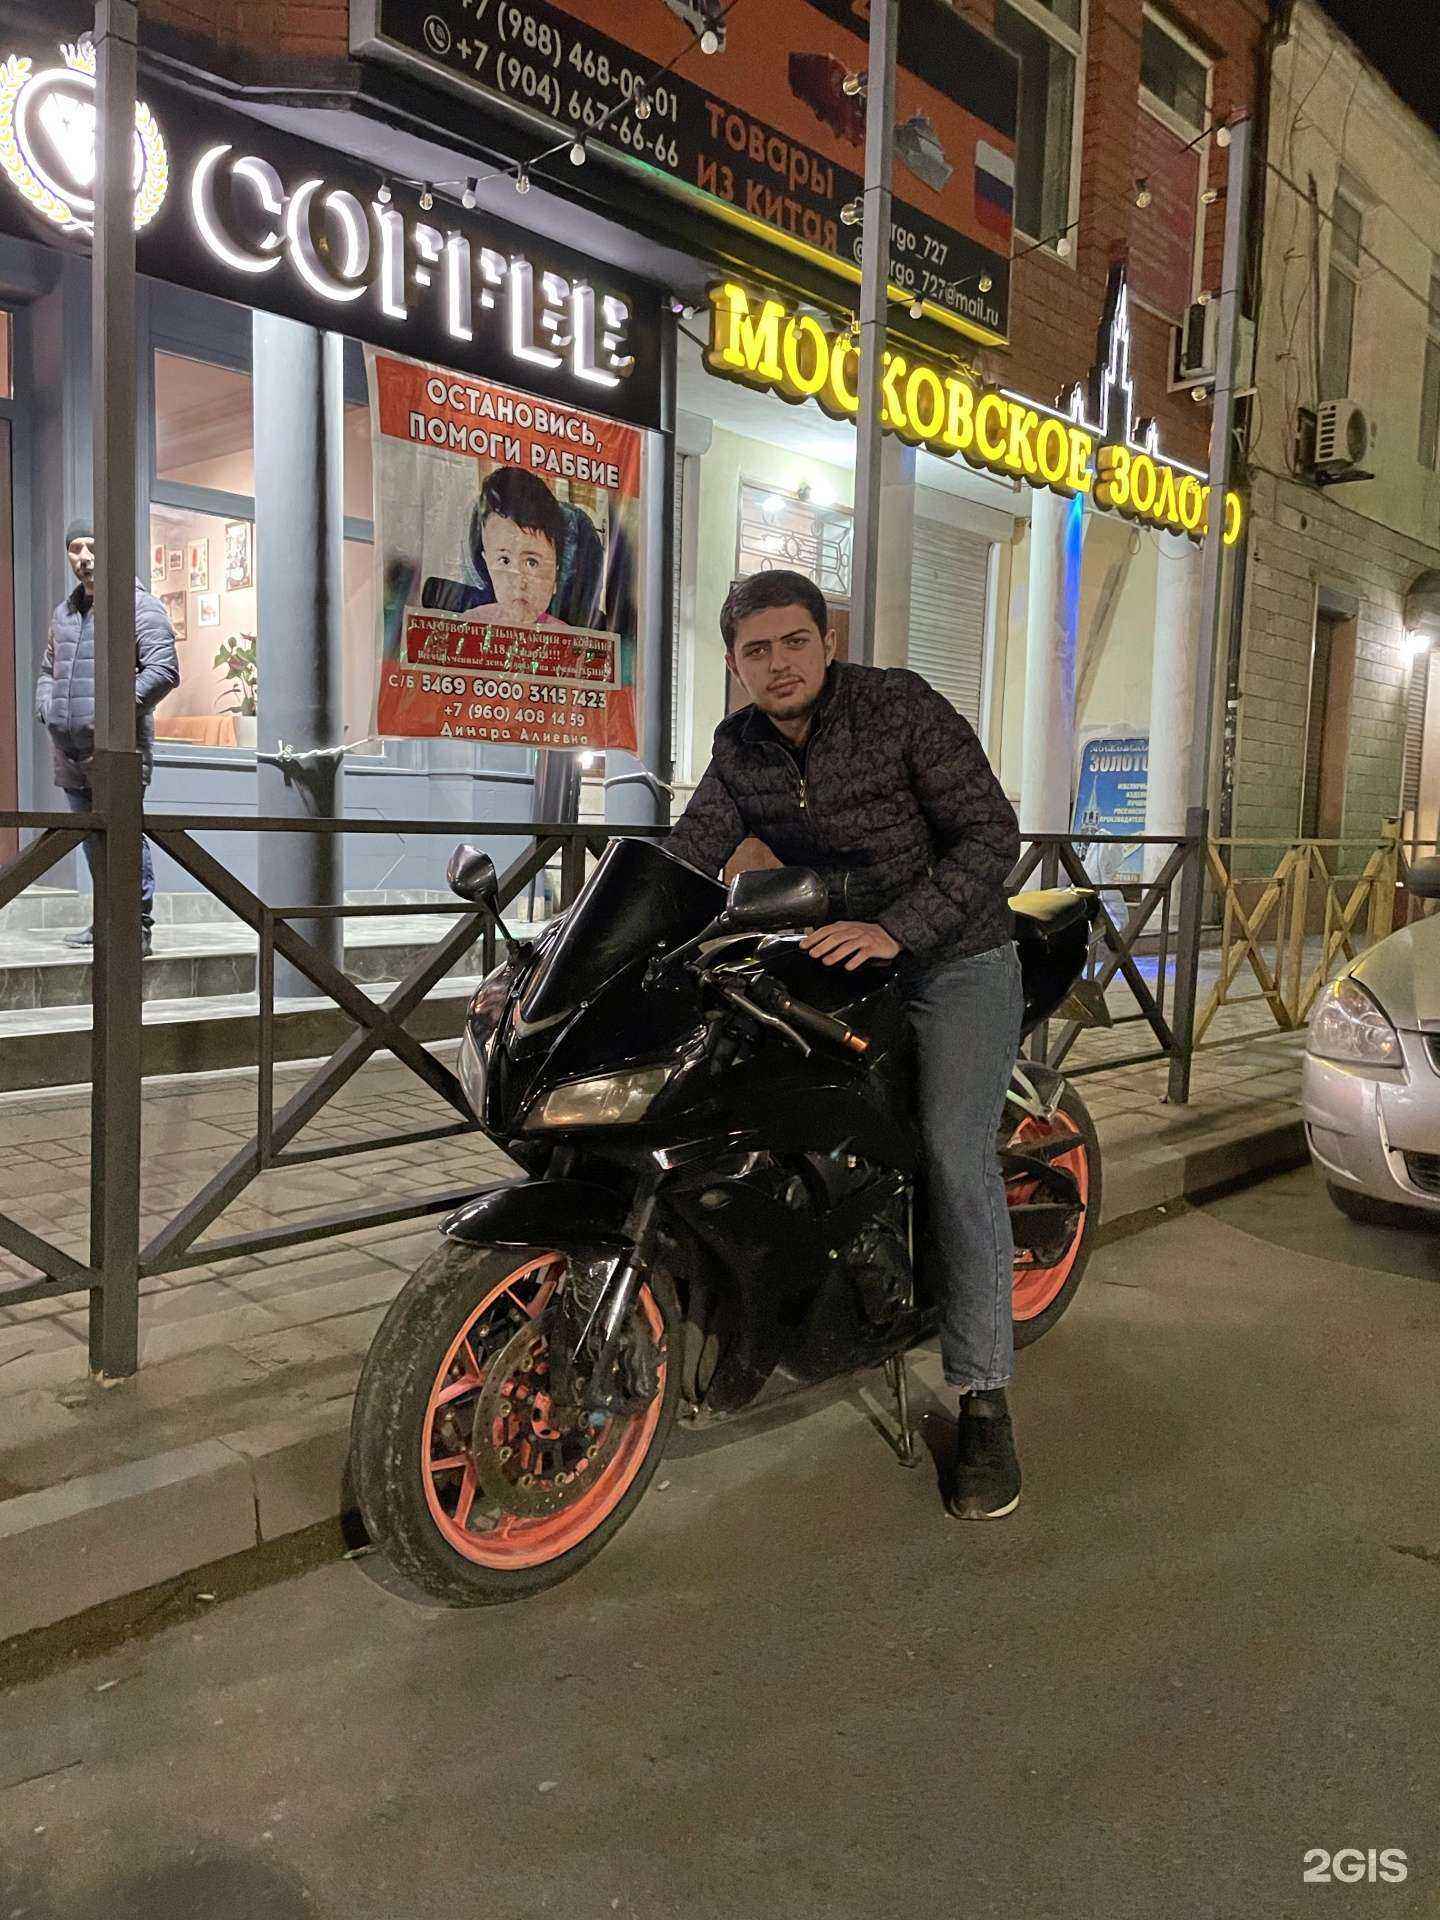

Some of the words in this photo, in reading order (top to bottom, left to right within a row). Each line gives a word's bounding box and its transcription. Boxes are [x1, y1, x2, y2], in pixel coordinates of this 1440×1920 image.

[498, 2, 562, 68] (988)
[457, 38, 488, 71] +7
[497, 52, 560, 117] (904)
[568, 90, 679, 168] 667-66-66
[192, 145, 634, 387] COFFEE
[891, 223, 949, 266] rgo_727
[889, 260, 999, 326] rgo_727@mail.ru
[426, 378, 604, 453] ОСТАНОВИСЬ,
[409, 411, 521, 465] ПОМОГИ
[530, 444, 620, 490] РАББИЕ
[1106, 444, 1242, 545] ЗОЛОО
[422, 674, 466, 696] 5469
[472, 678, 524, 701] 6000
[529, 685, 567, 706] 3115
[444, 703, 462, 717] +7
[468, 703, 511, 722] (960)
[514, 708, 545, 724] 408
[551, 711, 565, 726] 14
[570, 713, 585, 727] 59
[440, 721, 511, 741] Динара
